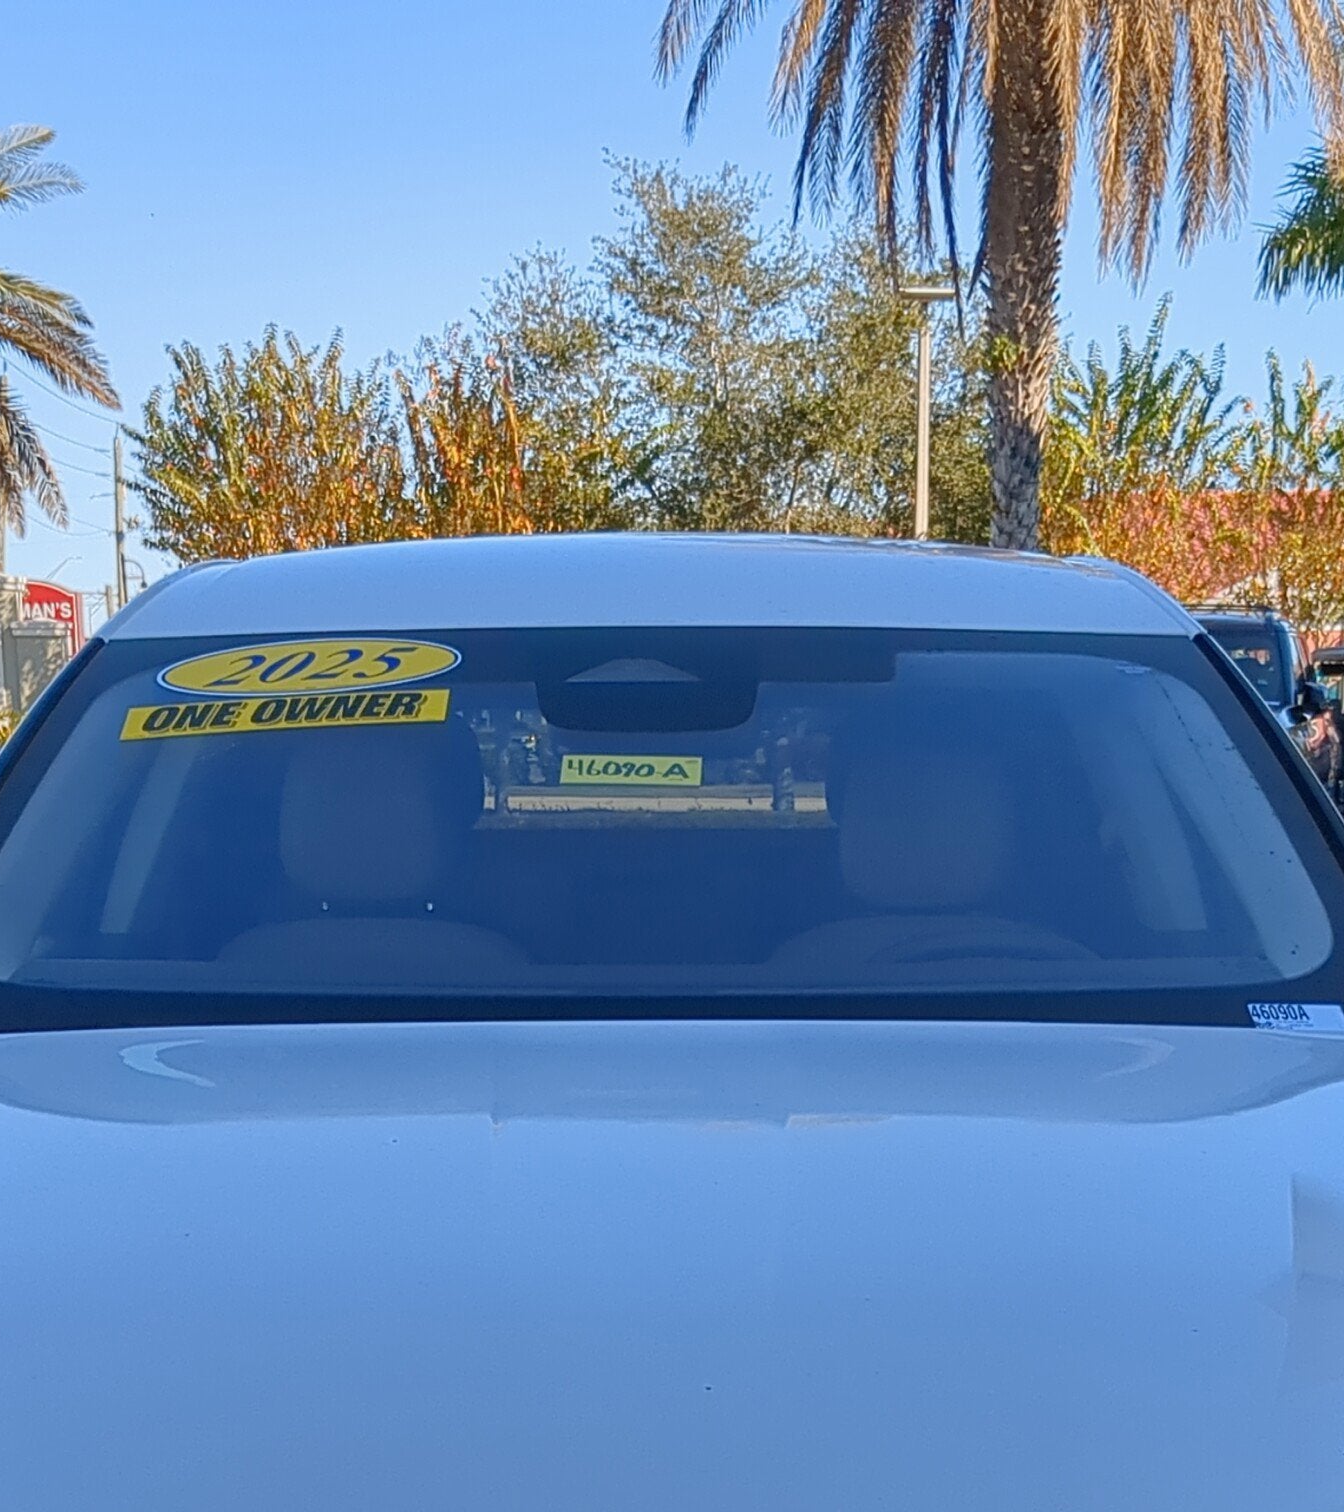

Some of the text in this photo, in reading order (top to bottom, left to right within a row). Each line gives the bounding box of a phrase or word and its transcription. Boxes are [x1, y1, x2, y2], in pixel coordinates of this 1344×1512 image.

[204, 646, 419, 688] 2025
[143, 692, 429, 734] ONE OWNER
[1251, 1004, 1311, 1021] 46090A
